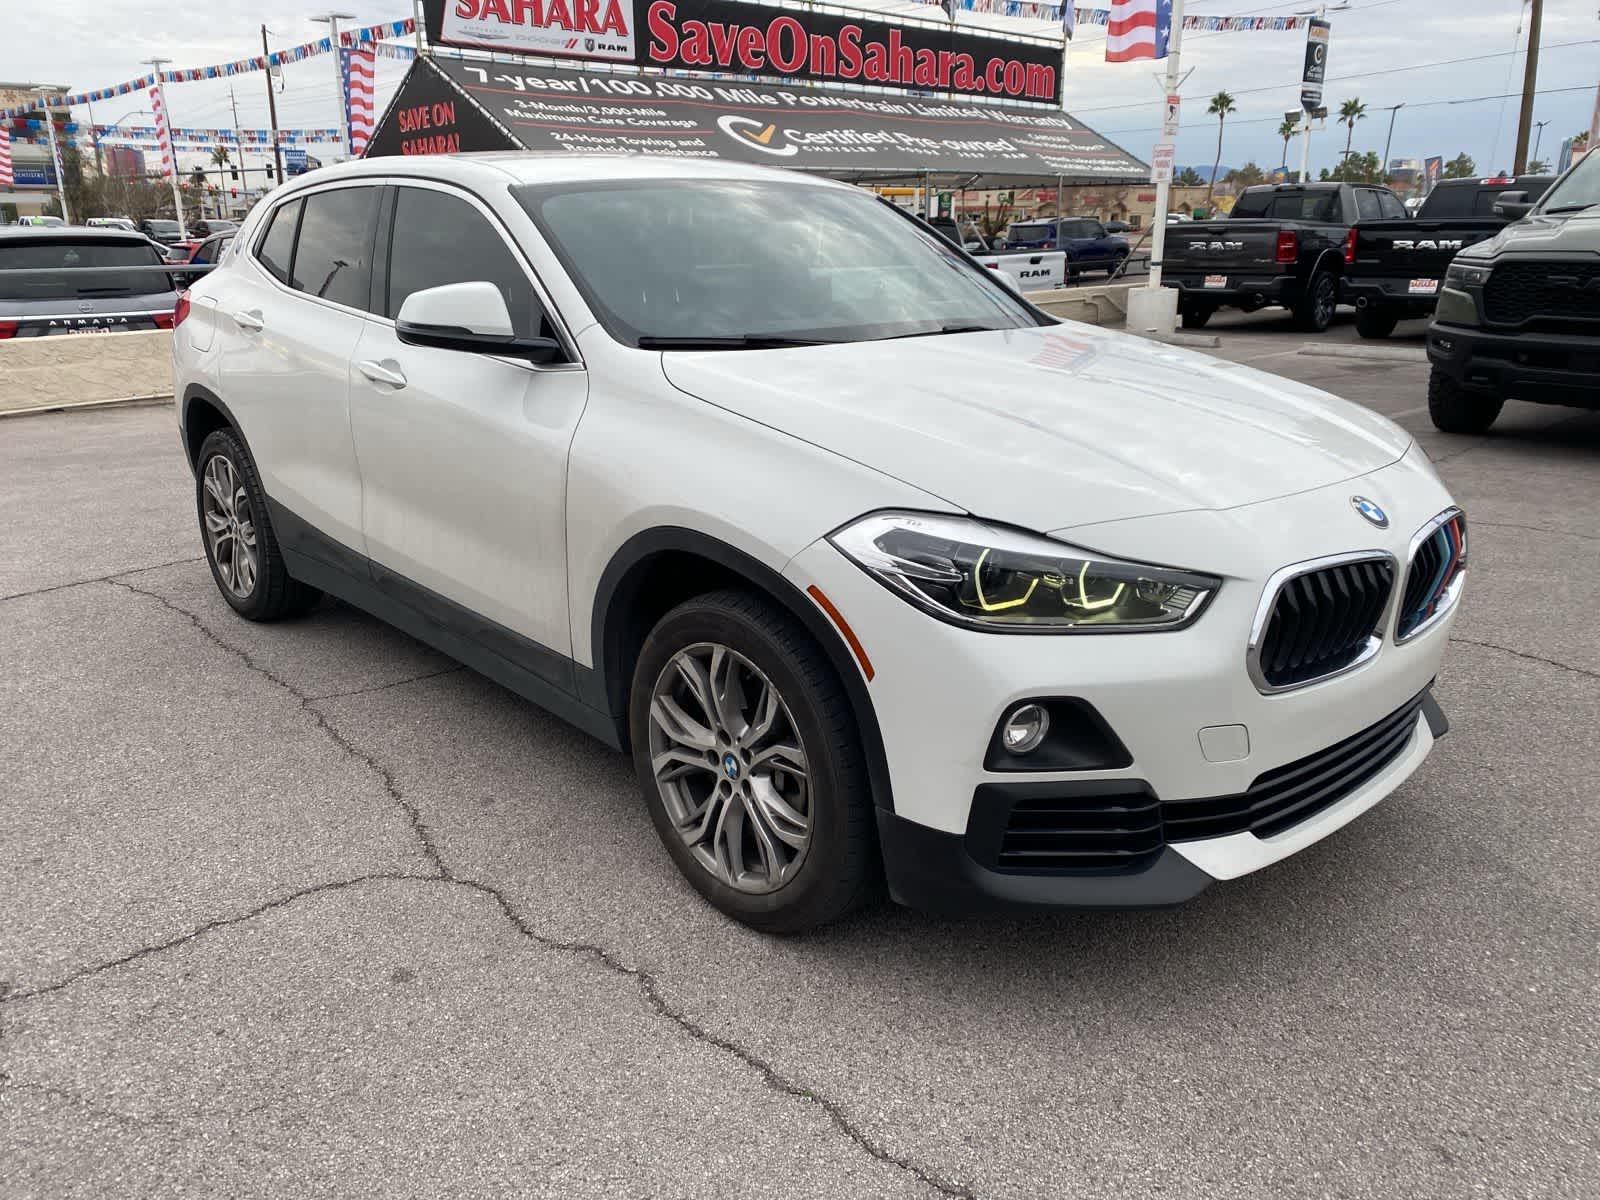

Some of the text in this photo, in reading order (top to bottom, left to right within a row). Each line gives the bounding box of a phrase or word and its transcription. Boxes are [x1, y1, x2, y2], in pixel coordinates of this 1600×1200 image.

[598, 44, 628, 52] RAM
[648, 0, 1055, 99] SaveOnSahara.com
[464, 66, 1073, 130] 7-year/100,000 Mile Powertrain Limited Warranty
[398, 101, 456, 133] SAVE ON
[503, 107, 699, 128] Maximum Care Coverage
[549, 131, 706, 149] 24-Hour Towing and
[783, 128, 898, 146] Certified
[893, 131, 1019, 153] Pre-owned
[1189, 240, 1244, 250] RAM
[1392, 239, 1464, 250] RAM
[1020, 268, 1051, 279] RAM
[49, 317, 128, 326] ARMADA
